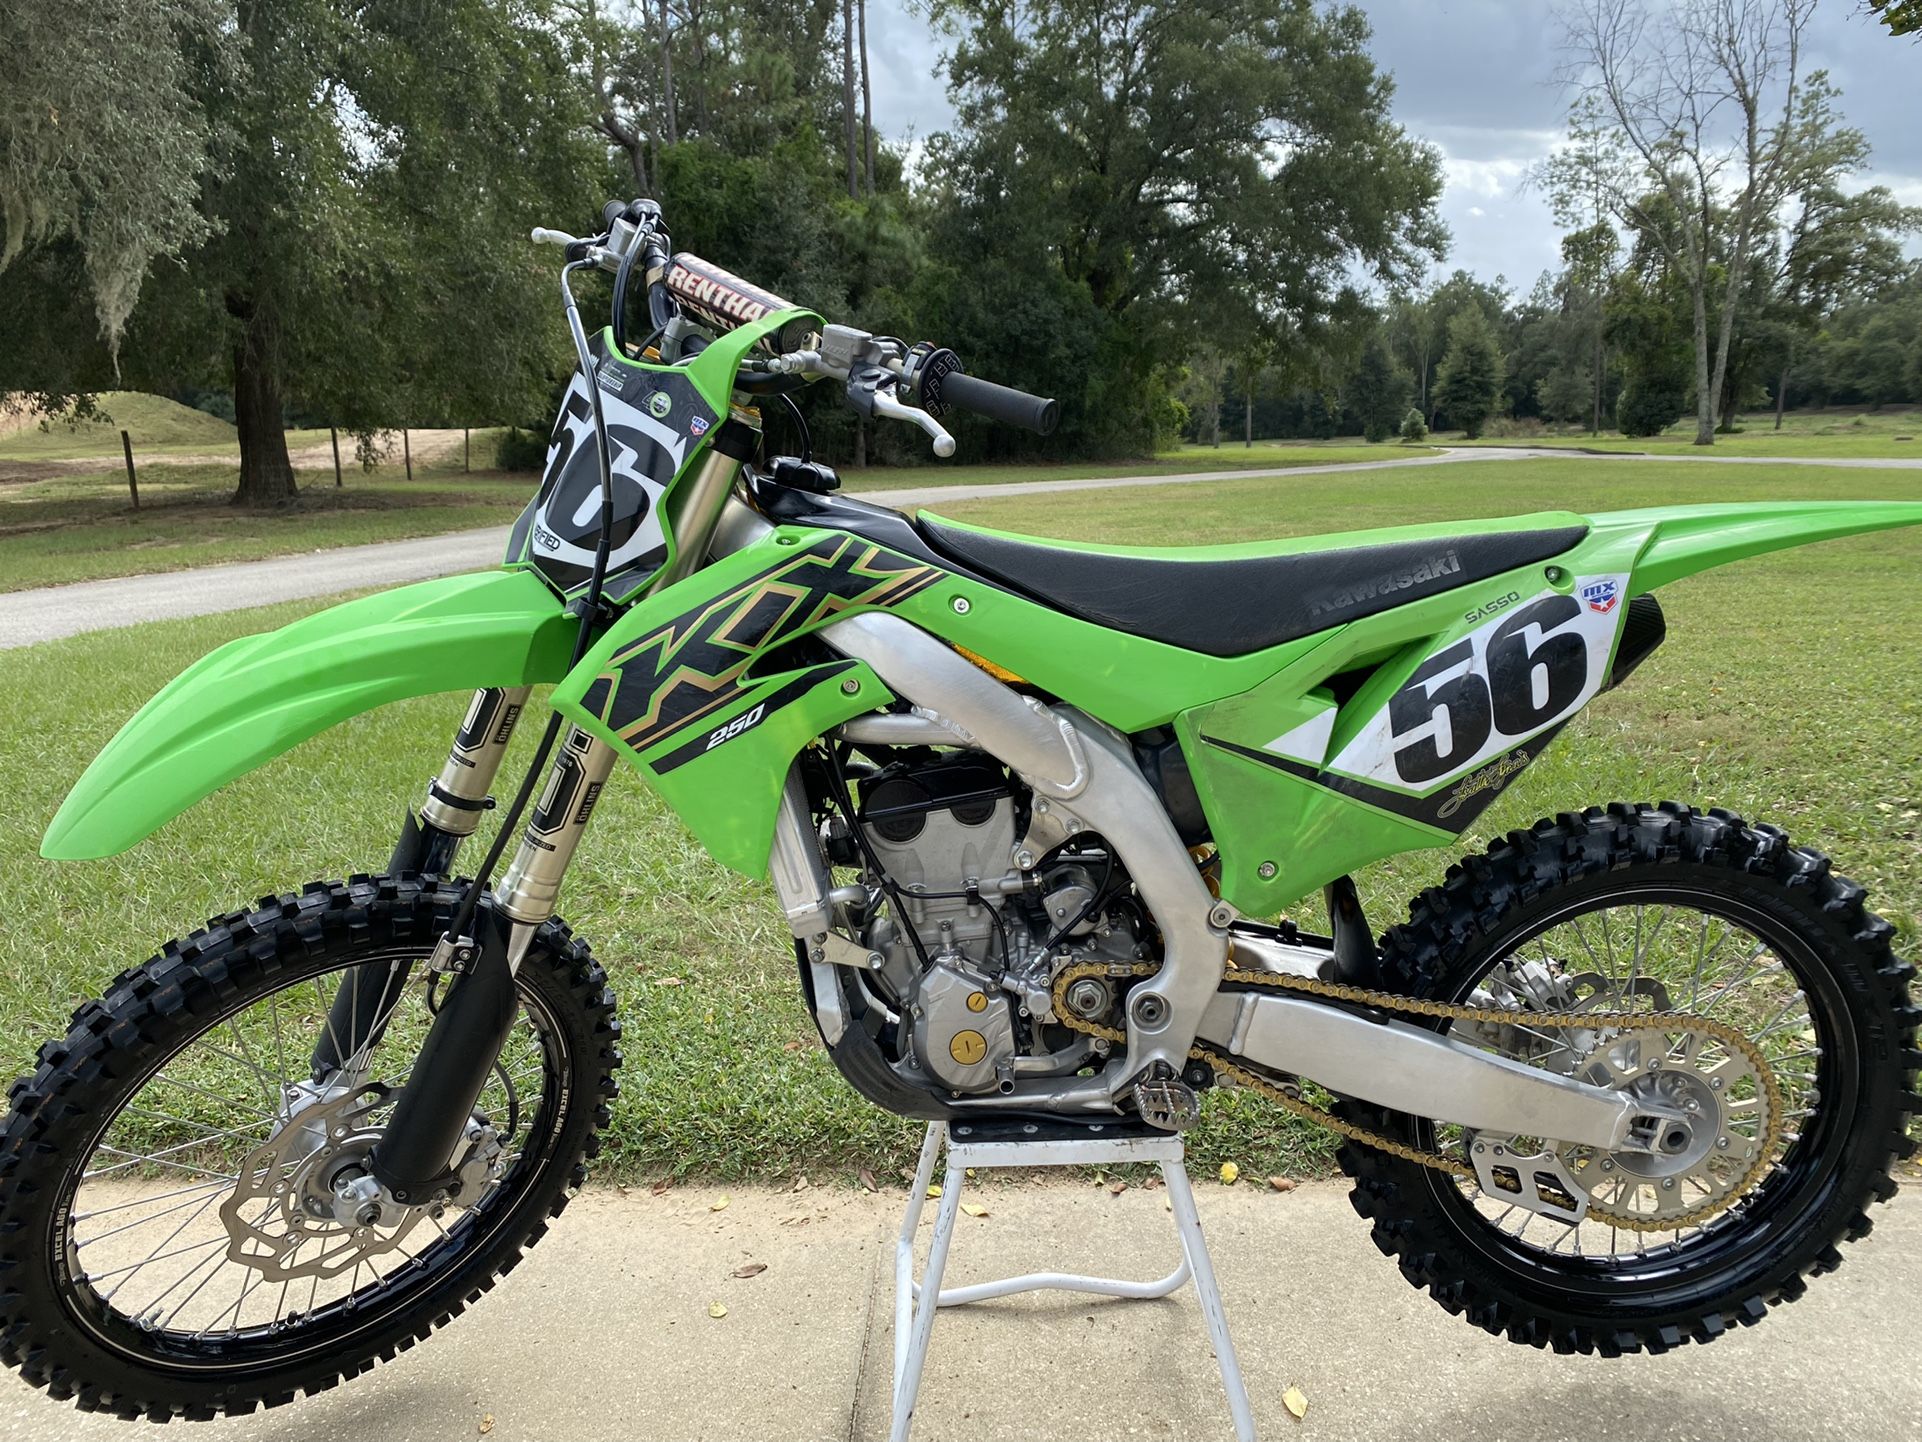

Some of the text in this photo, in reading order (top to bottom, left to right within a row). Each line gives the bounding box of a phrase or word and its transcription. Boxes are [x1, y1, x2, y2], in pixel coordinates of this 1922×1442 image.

[1464, 591, 1520, 624] SASSO
[1388, 595, 1587, 783] 56
[706, 703, 766, 751] 250
[54, 1228, 63, 1261] EXCEL
